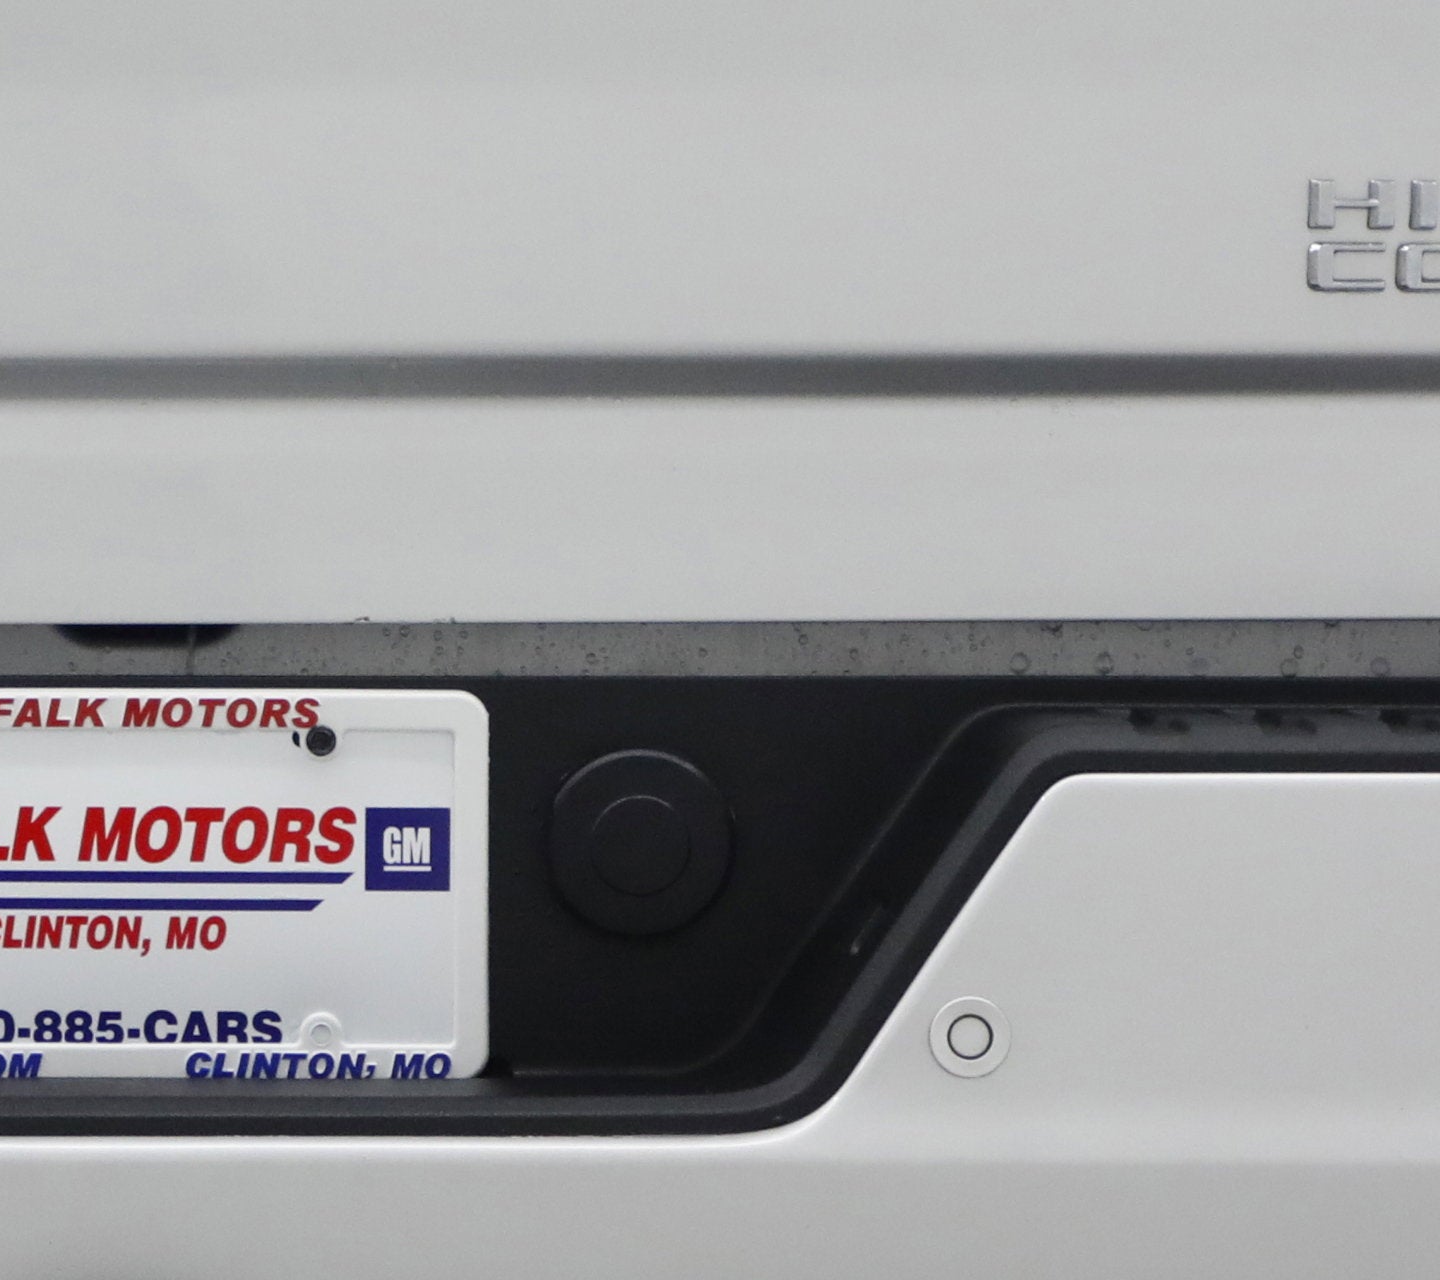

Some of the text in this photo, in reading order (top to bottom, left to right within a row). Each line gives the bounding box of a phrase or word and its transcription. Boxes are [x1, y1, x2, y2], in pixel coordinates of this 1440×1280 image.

[121, 698, 320, 729] MOTORS
[78, 805, 357, 865] MOTORS
[382, 826, 432, 865] GM
[165, 916, 228, 950] MO
[184, 1053, 454, 1079] CLINTON, MO
